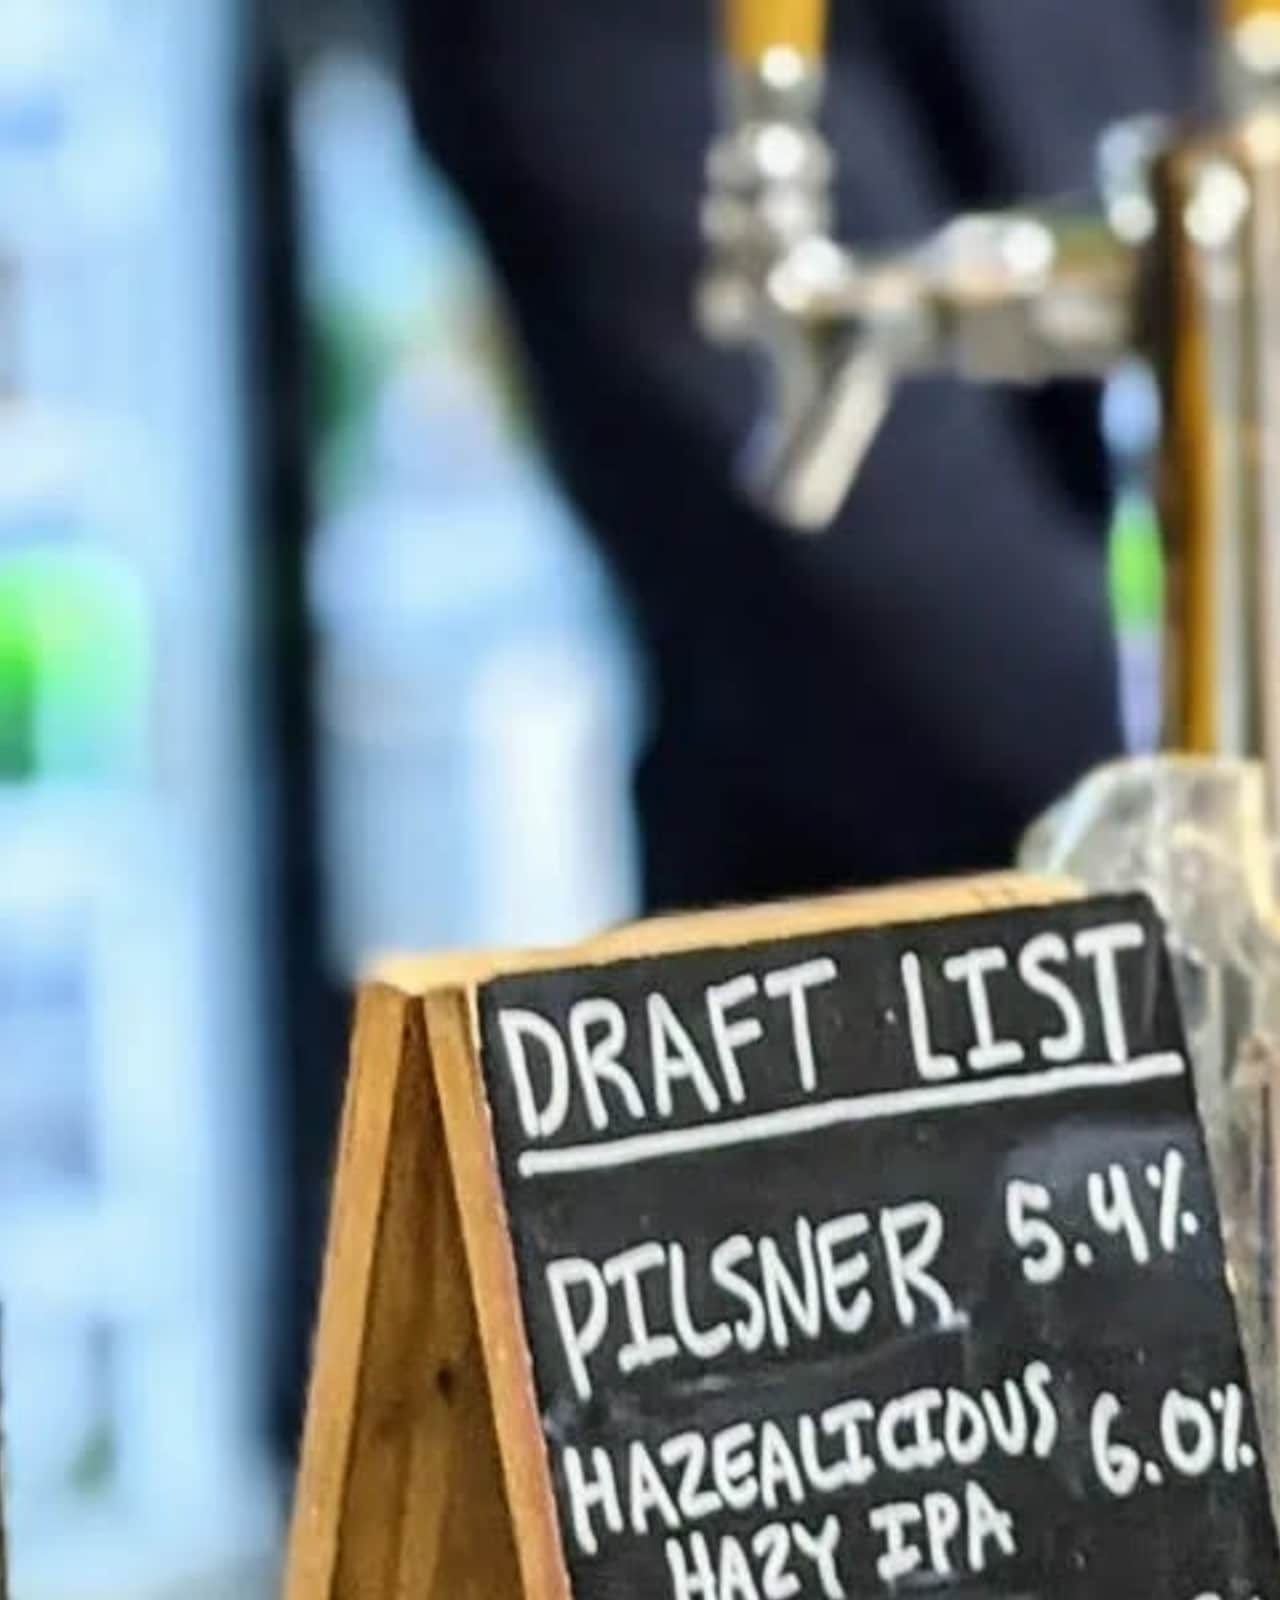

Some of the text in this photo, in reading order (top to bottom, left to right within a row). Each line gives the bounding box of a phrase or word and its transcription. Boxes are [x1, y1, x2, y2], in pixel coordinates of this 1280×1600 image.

[498, 922, 1145, 1139] DRAFT LIST
[545, 1148, 1200, 1400] PILSNER 5.4%
[563, 1361, 1257, 1555] HAZEALICIOUS 6.0%
[869, 1480, 1016, 1580] IPA
